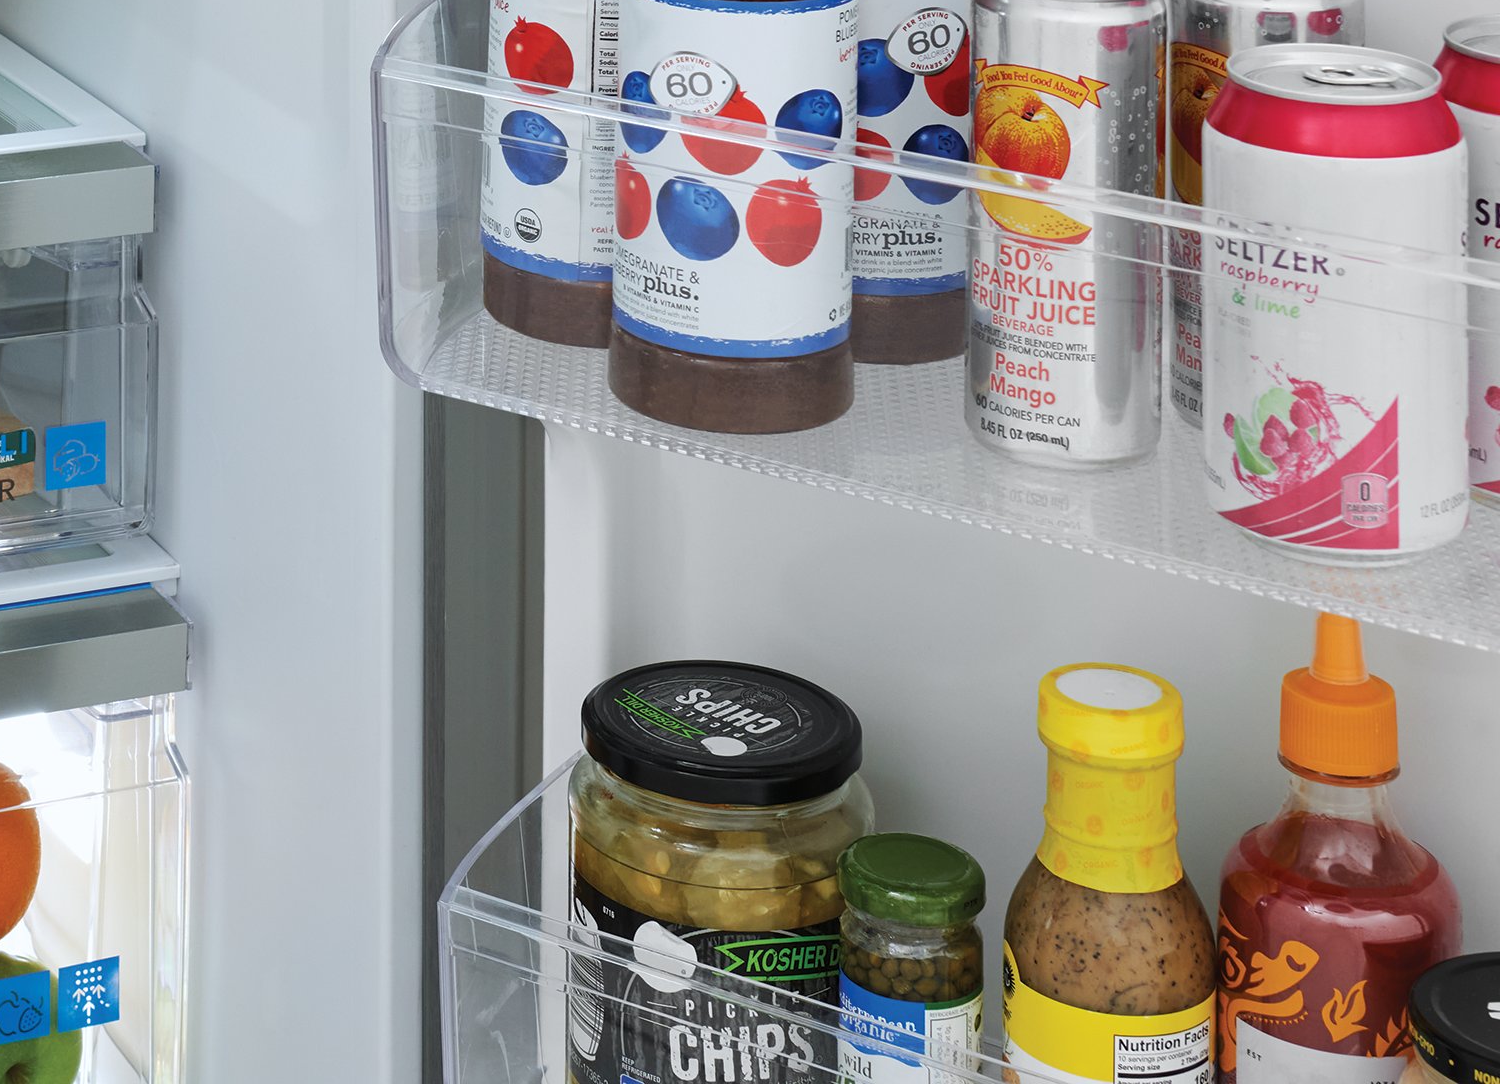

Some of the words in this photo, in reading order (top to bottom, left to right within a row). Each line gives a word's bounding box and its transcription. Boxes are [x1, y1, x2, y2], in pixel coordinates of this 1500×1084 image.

[902, 18, 917, 32] PER
[917, 12, 949, 22] SERVING
[917, 20, 937, 30] ONLY
[907, 24, 951, 56] 60
[661, 58, 675, 71] PER
[676, 56, 711, 68] SERVING
[910, 60, 944, 71] SERVING
[917, 46, 950, 63] CALORIES
[944, 48, 956, 64] PER
[1200, 50, 1219, 68] Good
[666, 71, 713, 98] 60
[1000, 69, 1013, 81] You
[1013, 71, 1029, 82] Feel
[1030, 73, 1053, 88] Good
[675, 97, 711, 106] CALORIES
[520, 216, 537, 226] USDA
[881, 230, 943, 250] plus.
[855, 249, 894, 258] VITAMINS
[904, 249, 936, 258] VITAMIN
[999, 243, 1053, 272] 50%
[1214, 234, 1331, 277] SELTZER
[642, 275, 699, 301] plus.
[973, 258, 1096, 302] SPARKLING
[1220, 261, 1320, 304] raspberry
[660, 299, 692, 312] VITAMIN
[972, 280, 1020, 316] FRUIT
[1026, 301, 1096, 325] JUICE
[1231, 287, 1246, 307] &
[1254, 293, 1302, 320] lime
[991, 312, 1054, 337] BEVERAGE
[1001, 330, 1023, 344] JUICE
[1024, 336, 1064, 352] BLENDED
[1065, 343, 1088, 353] WITH
[1008, 343, 1032, 356] FROM
[1033, 348, 1097, 363] CONCENTRATE
[994, 351, 1050, 382] Peach
[989, 373, 1056, 409] Mango
[975, 393, 988, 410] 60
[988, 401, 1033, 422] CALORIES
[1034, 412, 1055, 425] PER
[1056, 415, 1081, 428] CAN
[980, 417, 996, 436] 8.45
[1009, 427, 1024, 440] OZ
[1026, 430, 1050, 444] (250
[1050, 434, 1071, 451] mL)
[620, 694, 644, 712] DILL
[675, 688, 783, 734] CHIPS
[640, 706, 683, 731] KOSHER
[670, 704, 747, 738] PICKLE
[746, 945, 826, 972] KOSHER
[841, 1006, 896, 1042] Organic
[1118, 1038, 1181, 1052] Nutrition
[1184, 1025, 1209, 1046] Facts
[621, 1055, 634, 1065] KEEP
[668, 1022, 816, 1083] CHIPS
[843, 1050, 873, 1079] wild
[1128, 1055, 1156, 1064] servings
[1246, 1048, 1262, 1061] EST
[621, 1063, 661, 1083] REFRIGERATED
[1117, 1064, 1146, 1072] Serving
